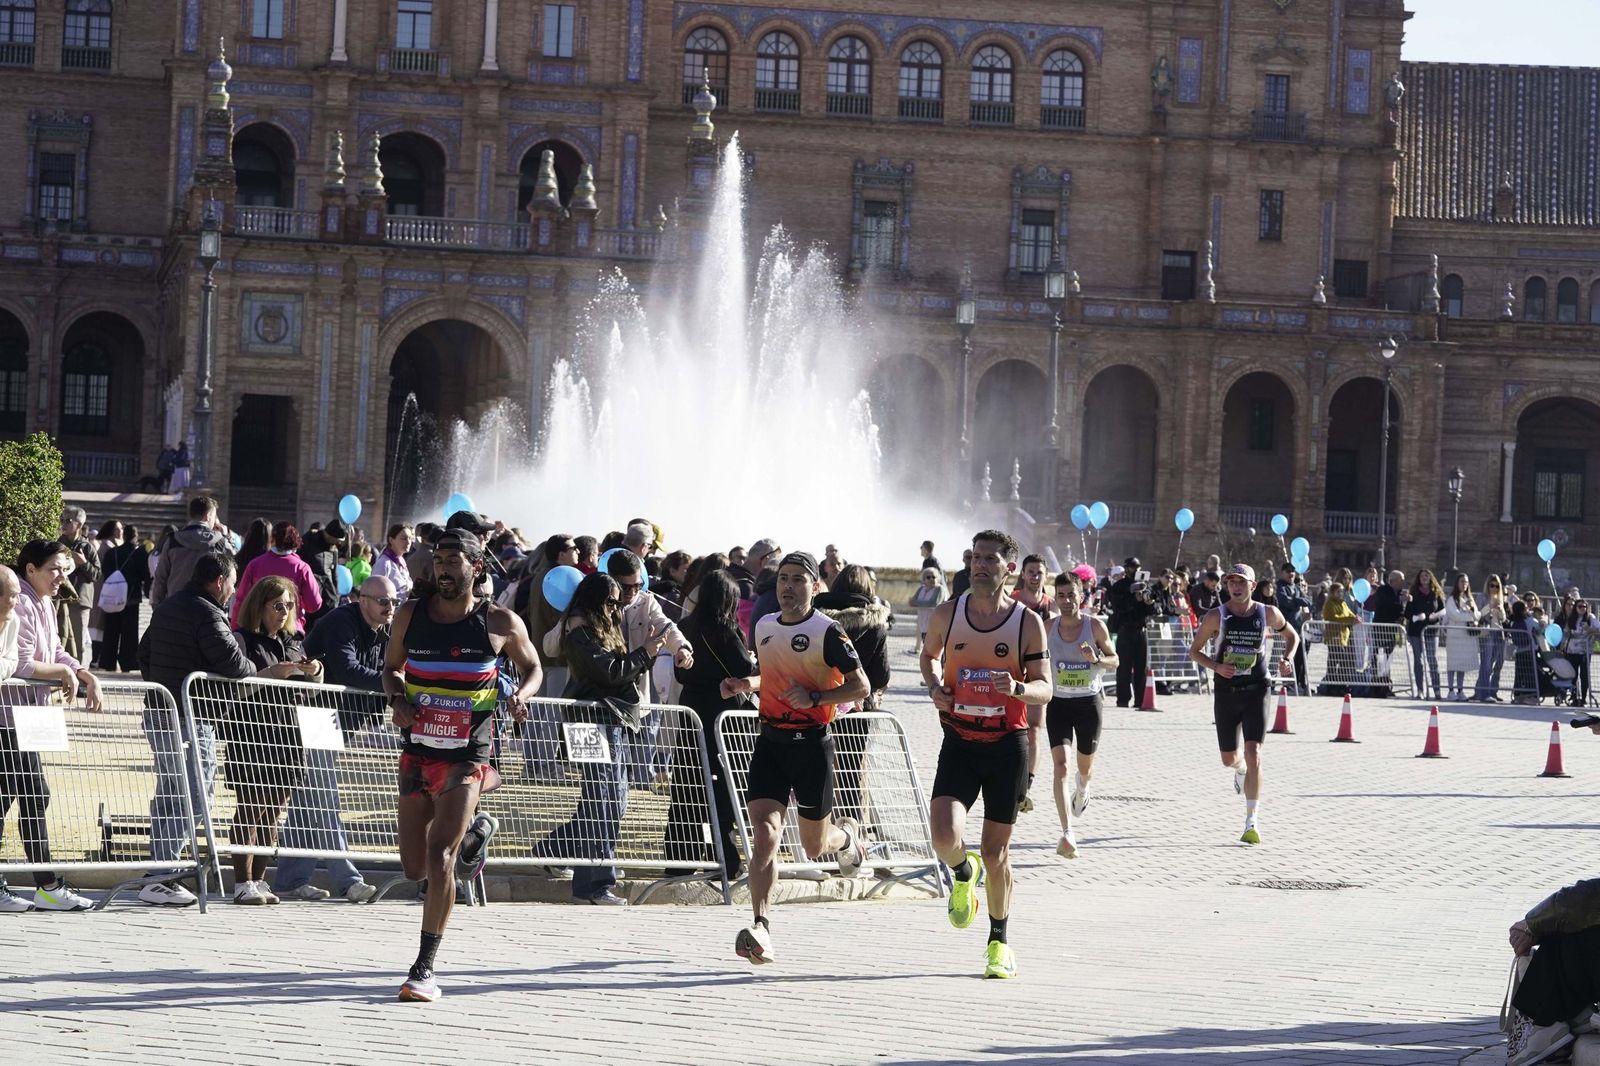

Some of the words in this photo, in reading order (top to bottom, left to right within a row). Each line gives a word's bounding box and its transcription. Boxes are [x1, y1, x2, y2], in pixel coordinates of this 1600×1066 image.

[974, 685, 990, 693] 1478
[434, 698, 466, 708] ZURICH
[434, 713, 450, 723] 1372
[423, 722, 458, 737] MIGUE
[574, 729, 597, 745] AMS
